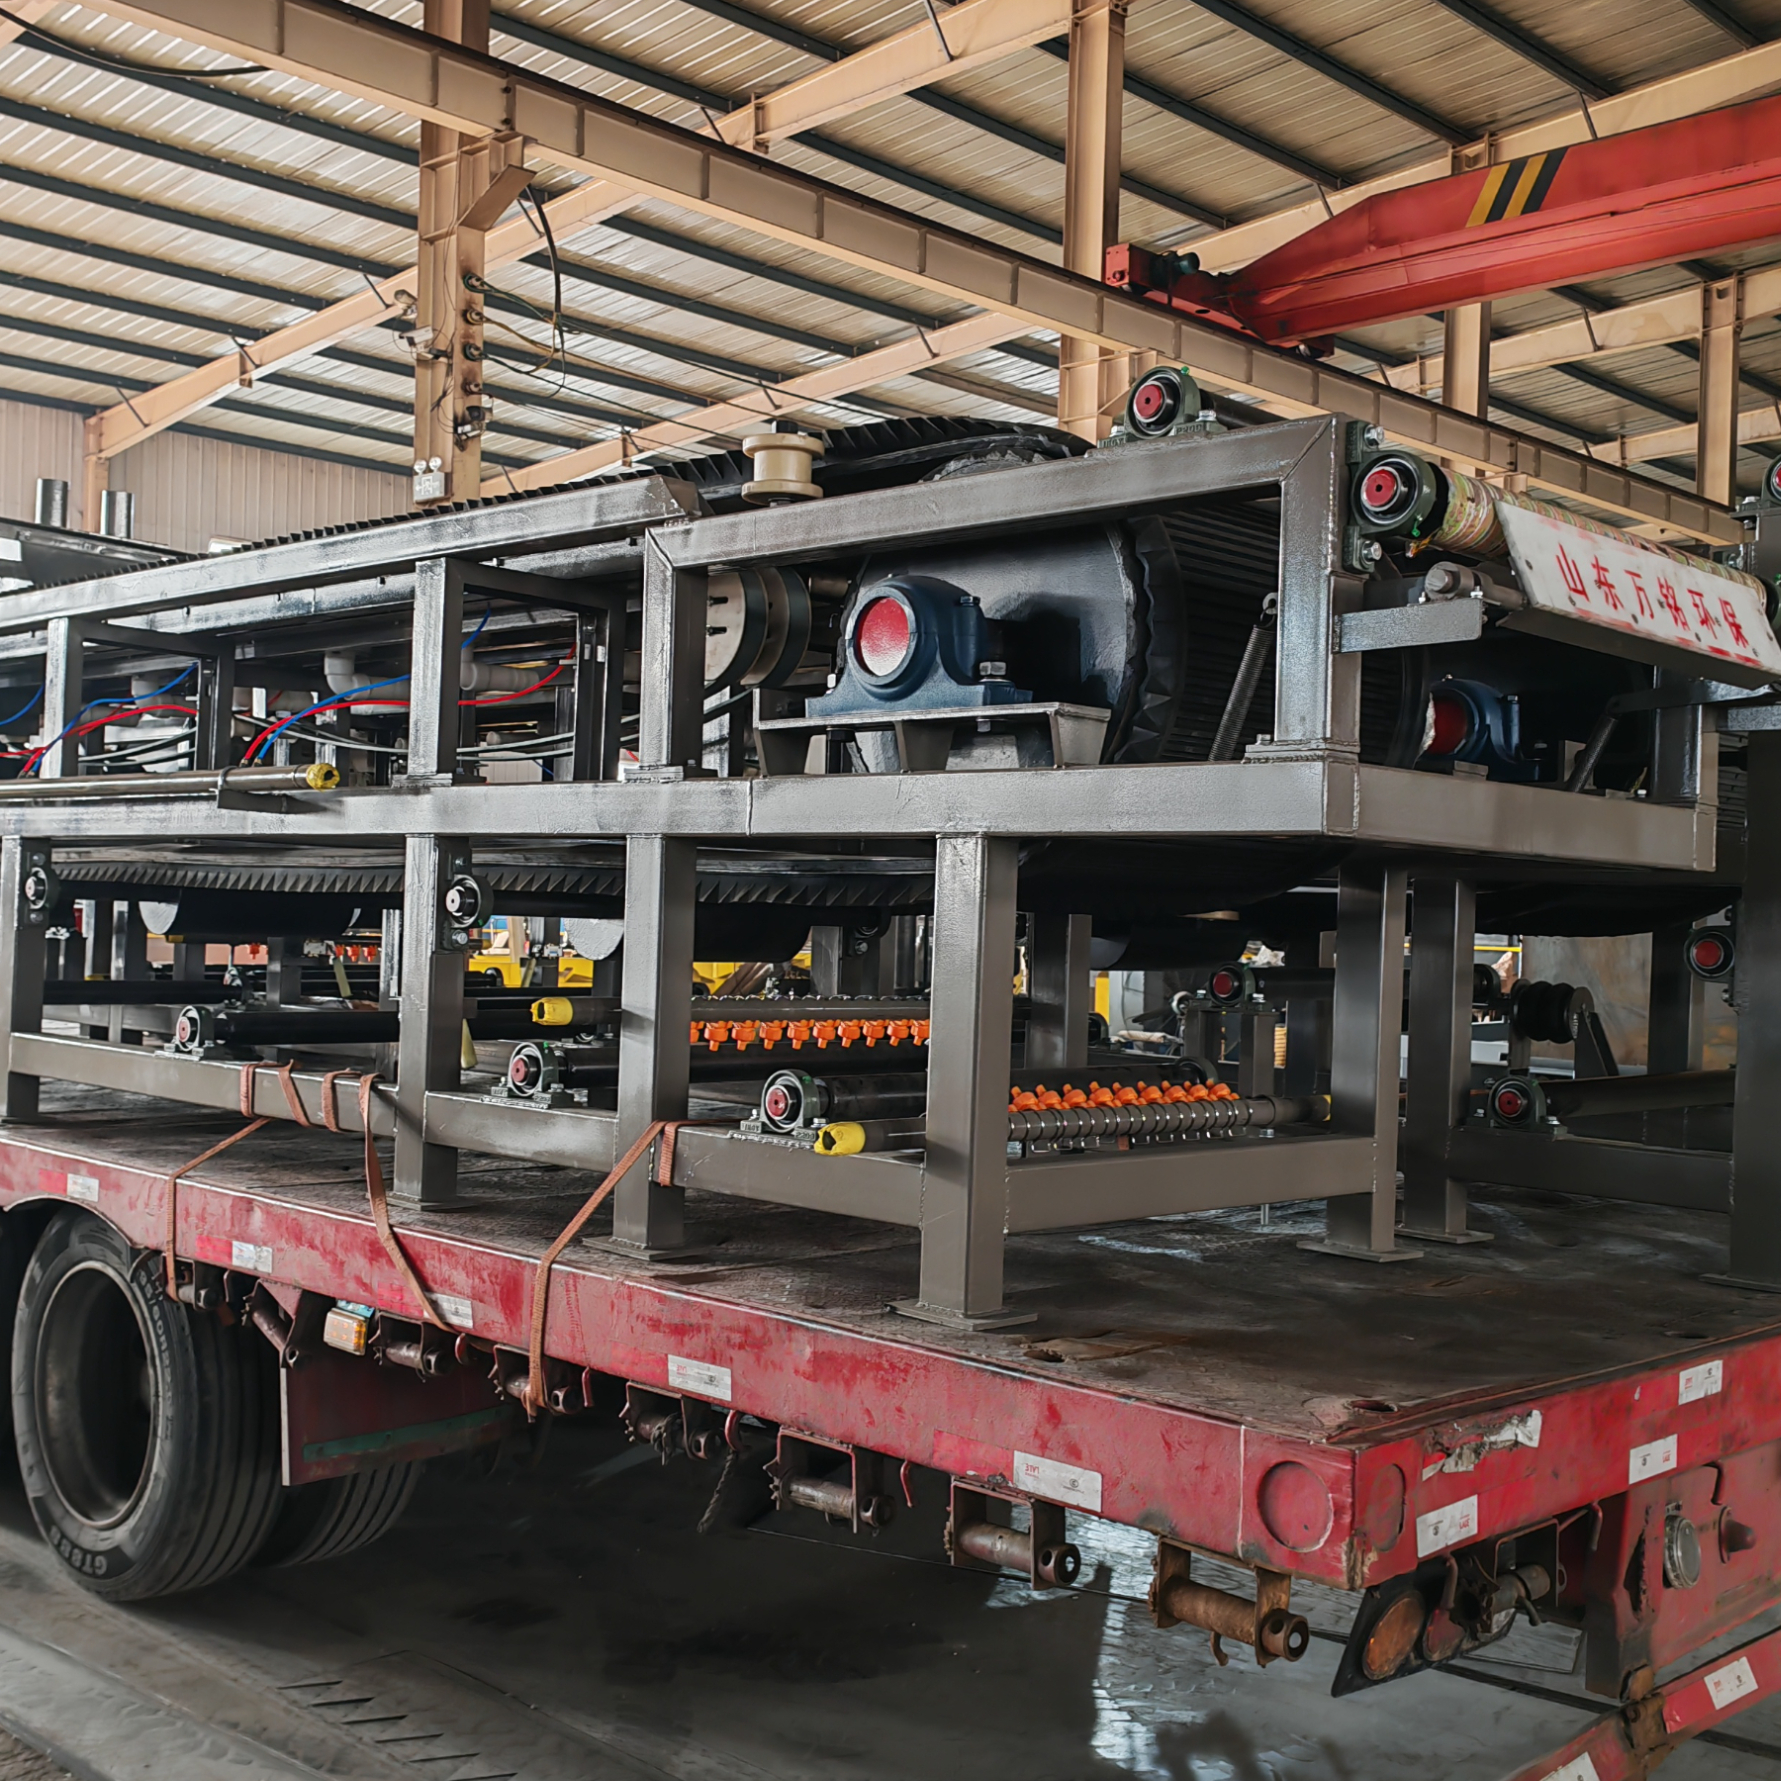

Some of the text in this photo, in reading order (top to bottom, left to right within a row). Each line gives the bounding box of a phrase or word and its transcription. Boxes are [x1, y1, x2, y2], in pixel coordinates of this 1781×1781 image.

[1556, 543, 1749, 649] 山东万铭环保
